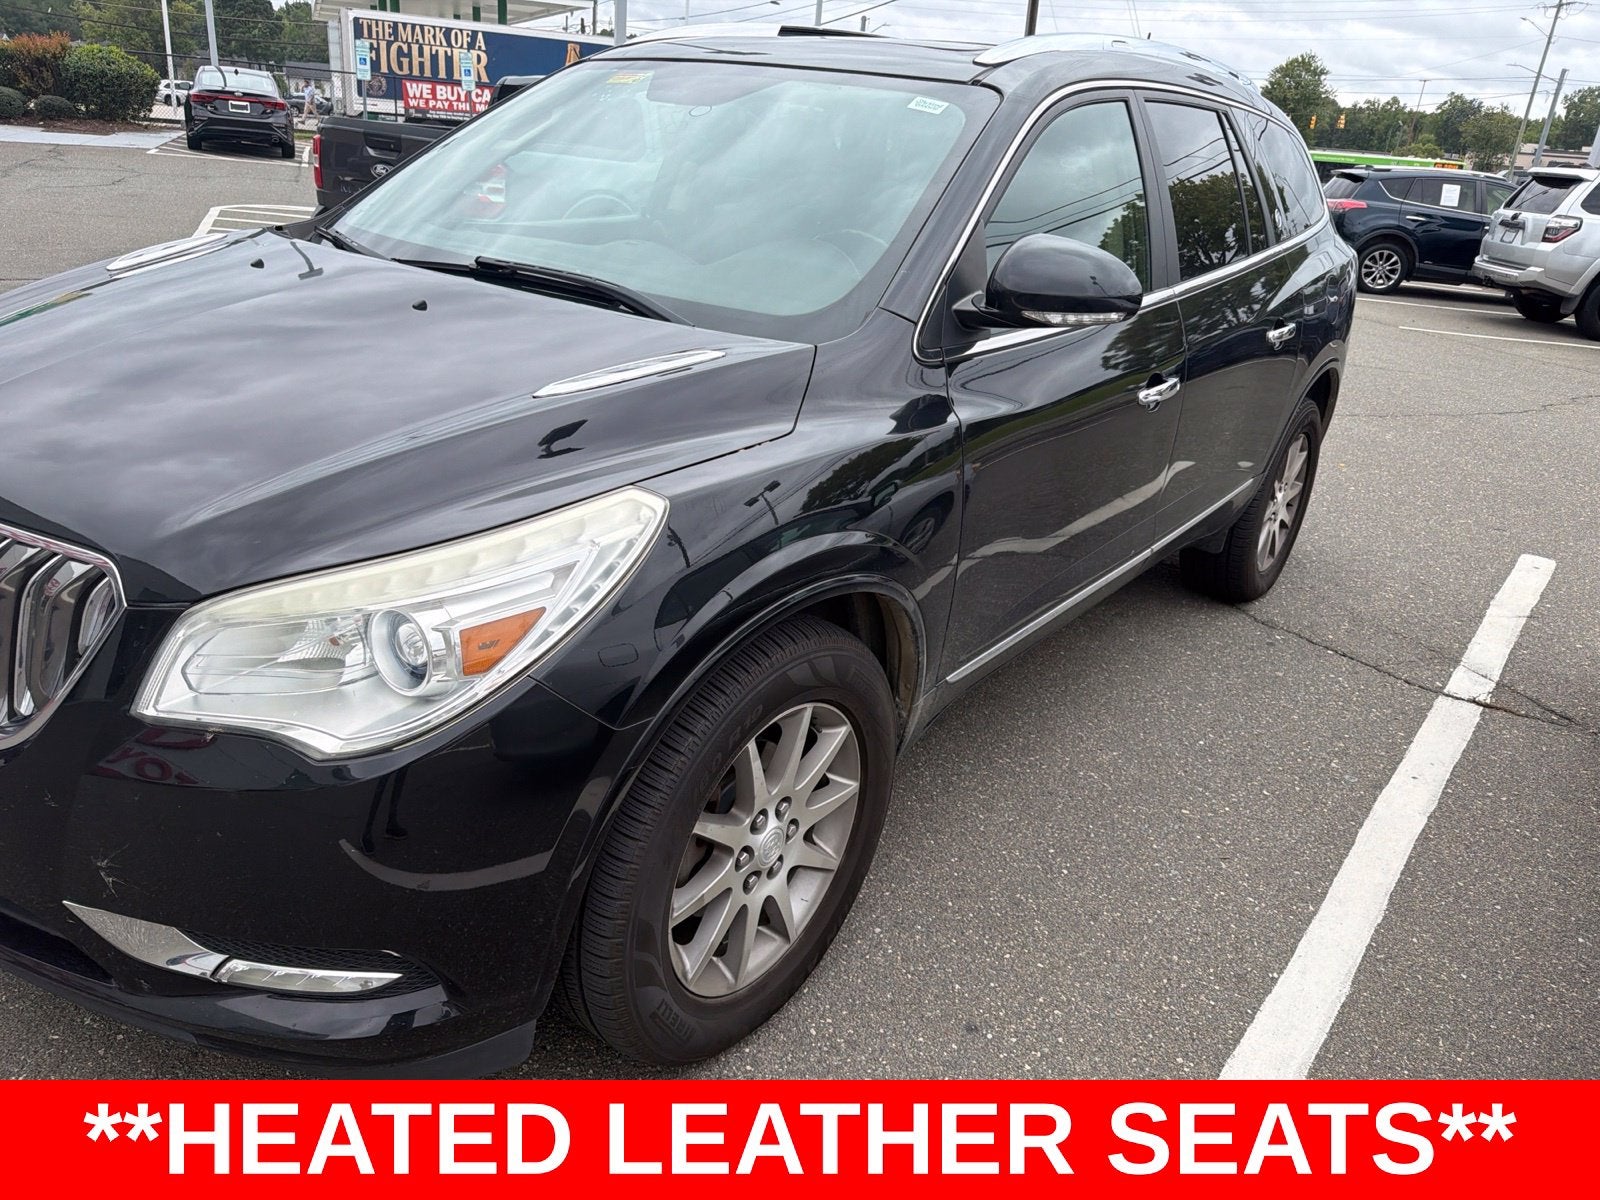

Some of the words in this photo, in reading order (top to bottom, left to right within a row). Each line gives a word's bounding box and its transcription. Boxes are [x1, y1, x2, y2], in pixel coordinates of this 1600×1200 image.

[359, 18, 394, 41] THE
[397, 21, 448, 47] MARK
[450, 29, 472, 49] OF
[475, 31, 487, 51] A
[405, 82, 432, 99] WE
[436, 84, 467, 102] BUY
[408, 98, 426, 107] WE
[428, 99, 450, 110] PAY
